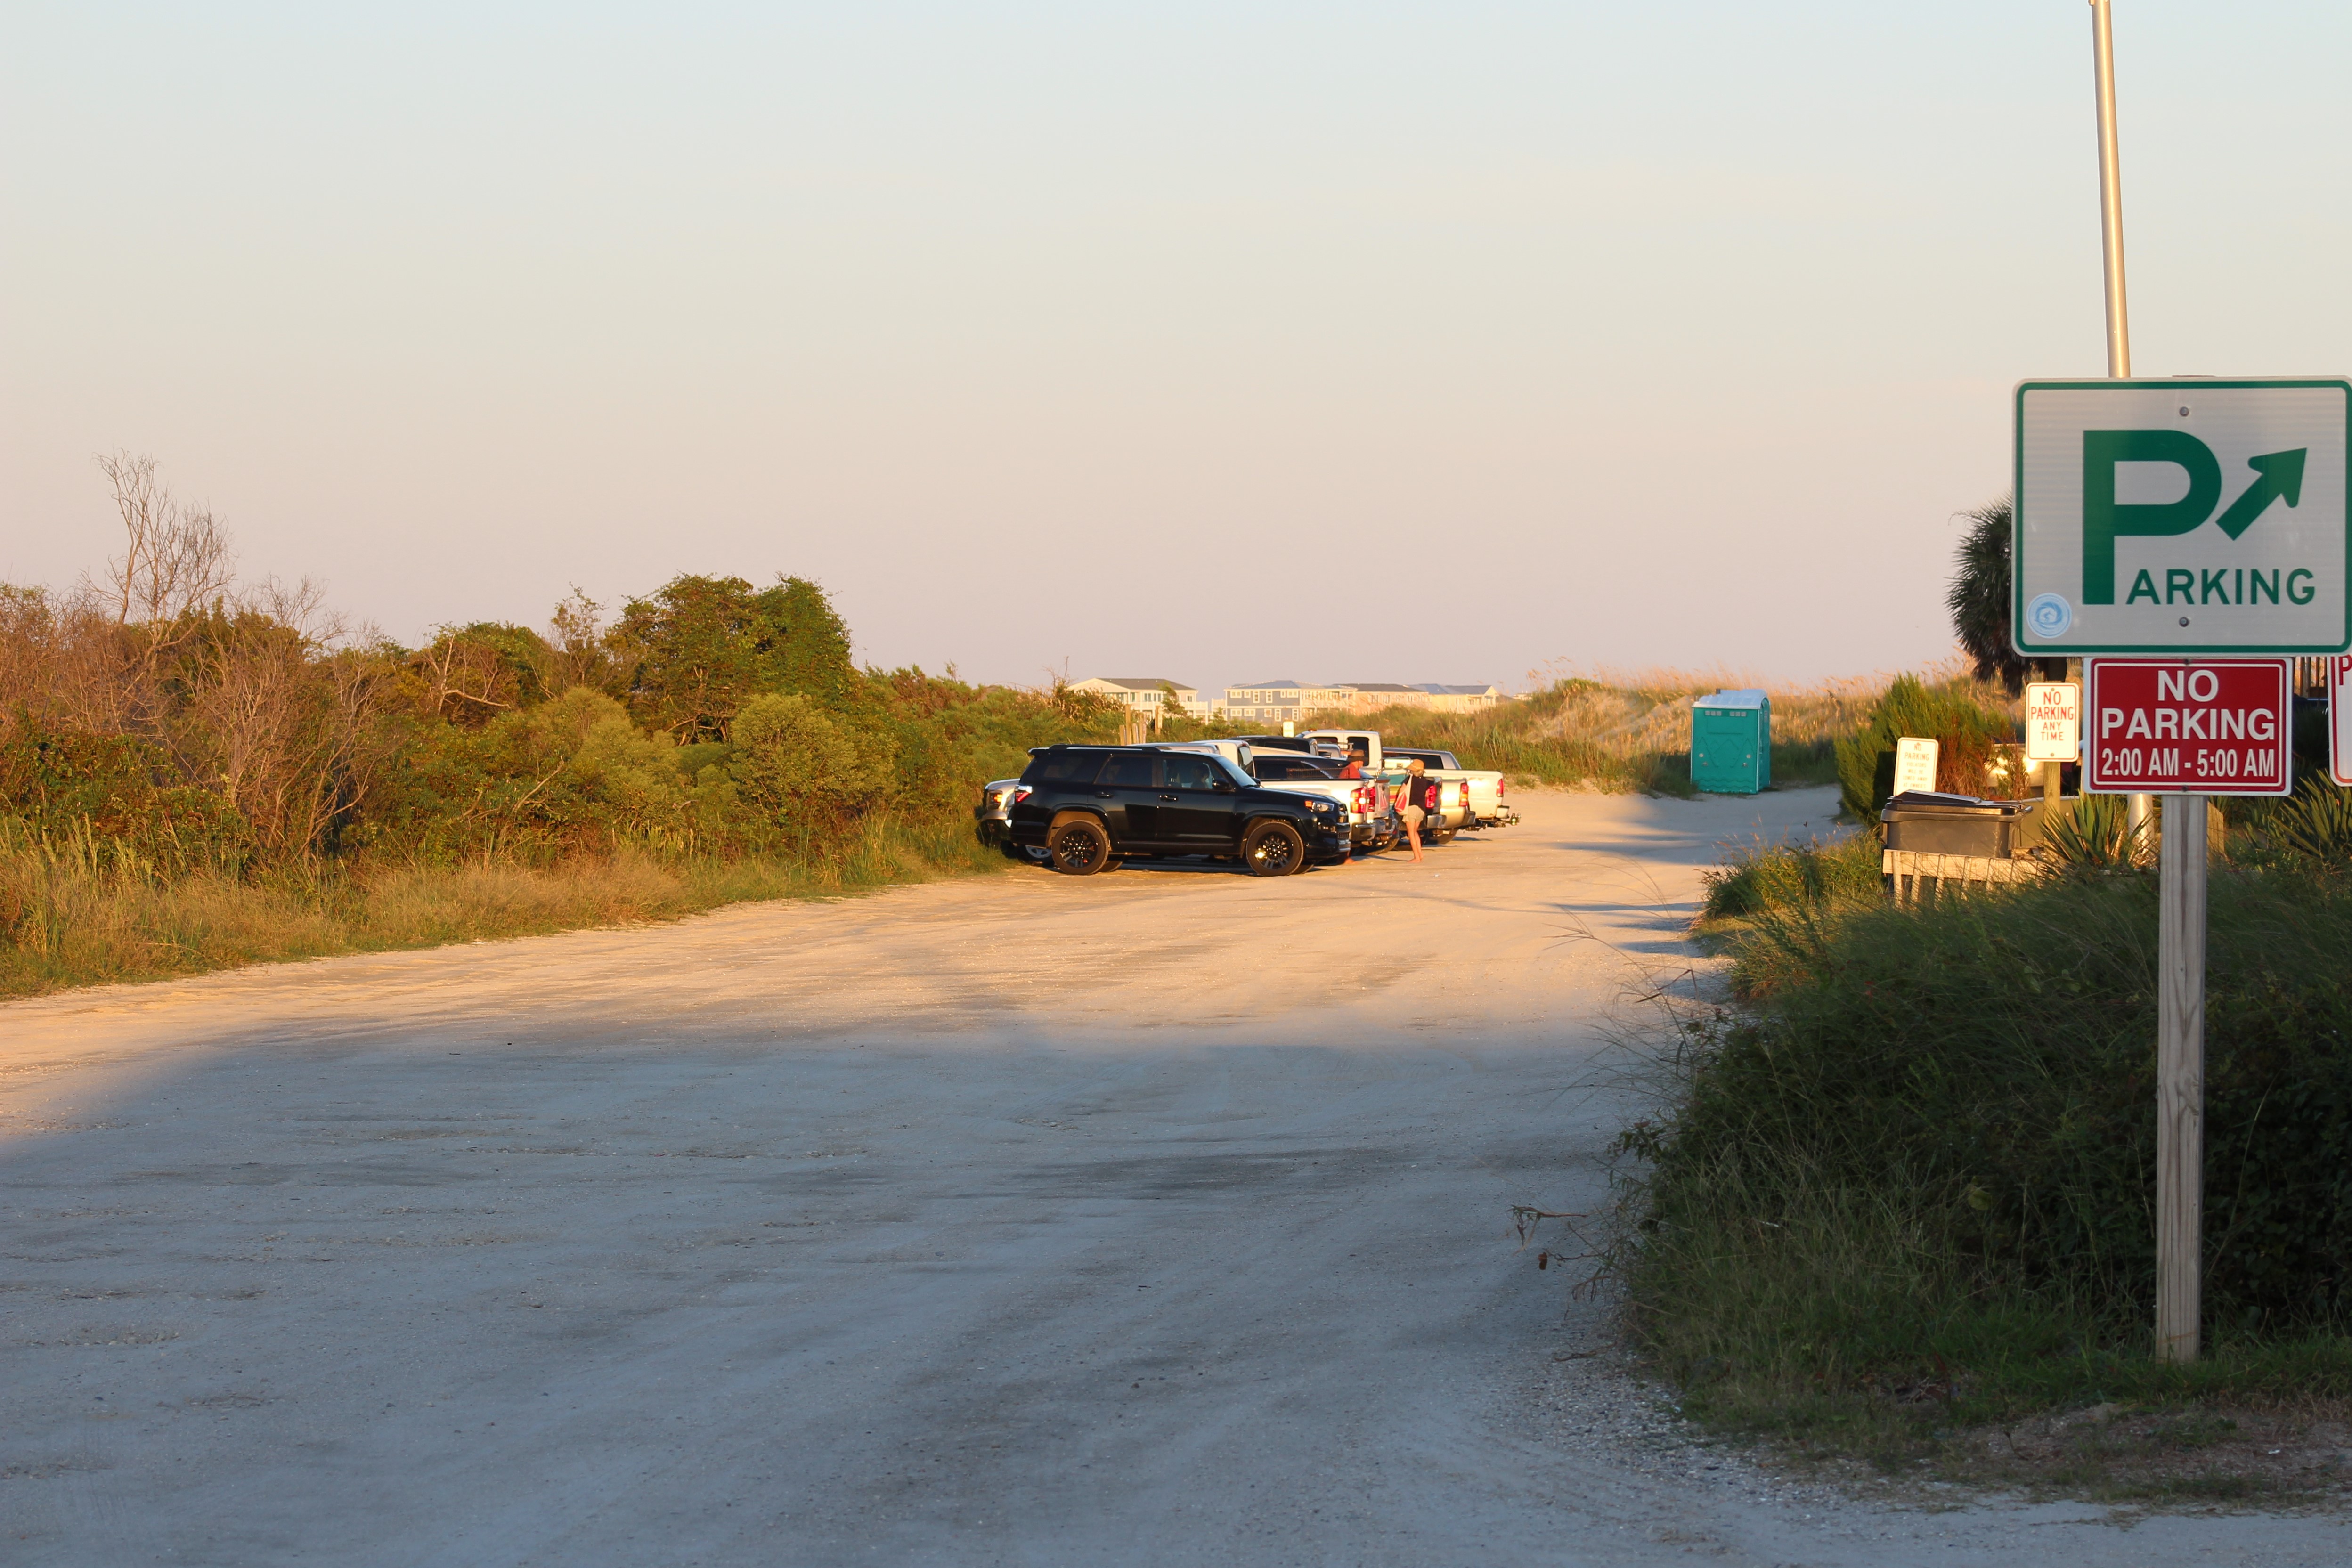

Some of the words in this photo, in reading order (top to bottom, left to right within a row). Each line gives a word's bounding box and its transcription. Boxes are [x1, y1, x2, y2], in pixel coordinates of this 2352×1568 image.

[2157, 669, 2219, 702] NO
[2043, 691, 2061, 705] NO
[2030, 707, 2074, 720] PARKING
[2043, 721, 2062, 731] ANY
[2101, 707, 2275, 741] PARKING
[2040, 731, 2064, 741] TIME
[1904, 752, 1929, 761] PARKING
[2101, 747, 2143, 777] 2:00
[2147, 747, 2179, 777] AM
[2197, 748, 2238, 778] 5:00
[2243, 748, 2275, 777] AM
